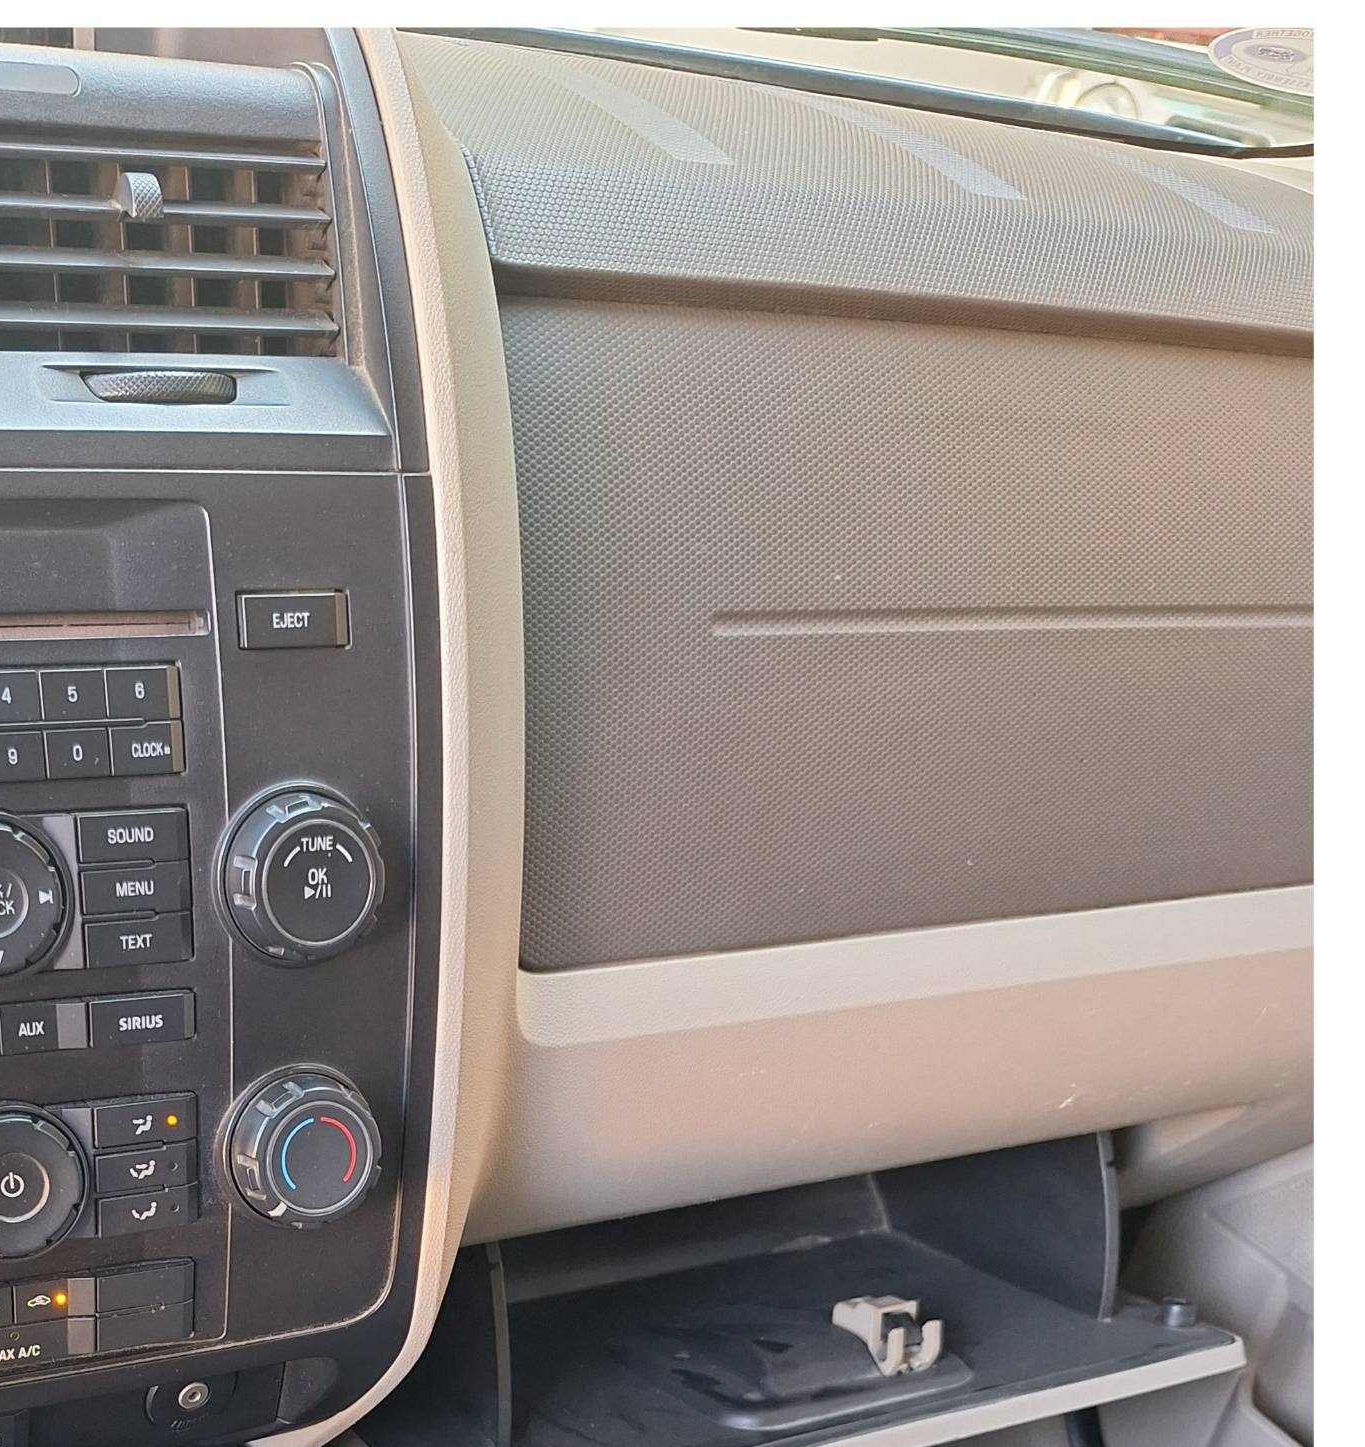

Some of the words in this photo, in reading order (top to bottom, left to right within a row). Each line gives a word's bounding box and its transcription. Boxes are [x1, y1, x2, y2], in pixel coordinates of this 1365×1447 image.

[272, 612, 309, 629] EJECT
[1, 687, 12, 704] 4
[68, 686, 78, 703] 5
[134, 682, 145, 699] 6
[8, 748, 18, 765] 9
[73, 745, 83, 762] 0
[107, 827, 154, 844] SOUND
[301, 836, 333, 852] TUNE
[308, 868, 328, 885] OK
[115, 880, 154, 898] MENU
[120, 933, 152, 950] TEXT
[18, 1020, 45, 1037] AUX
[119, 1013, 164, 1031] SIRIUS
[18, 1345, 41, 1359] A/C
